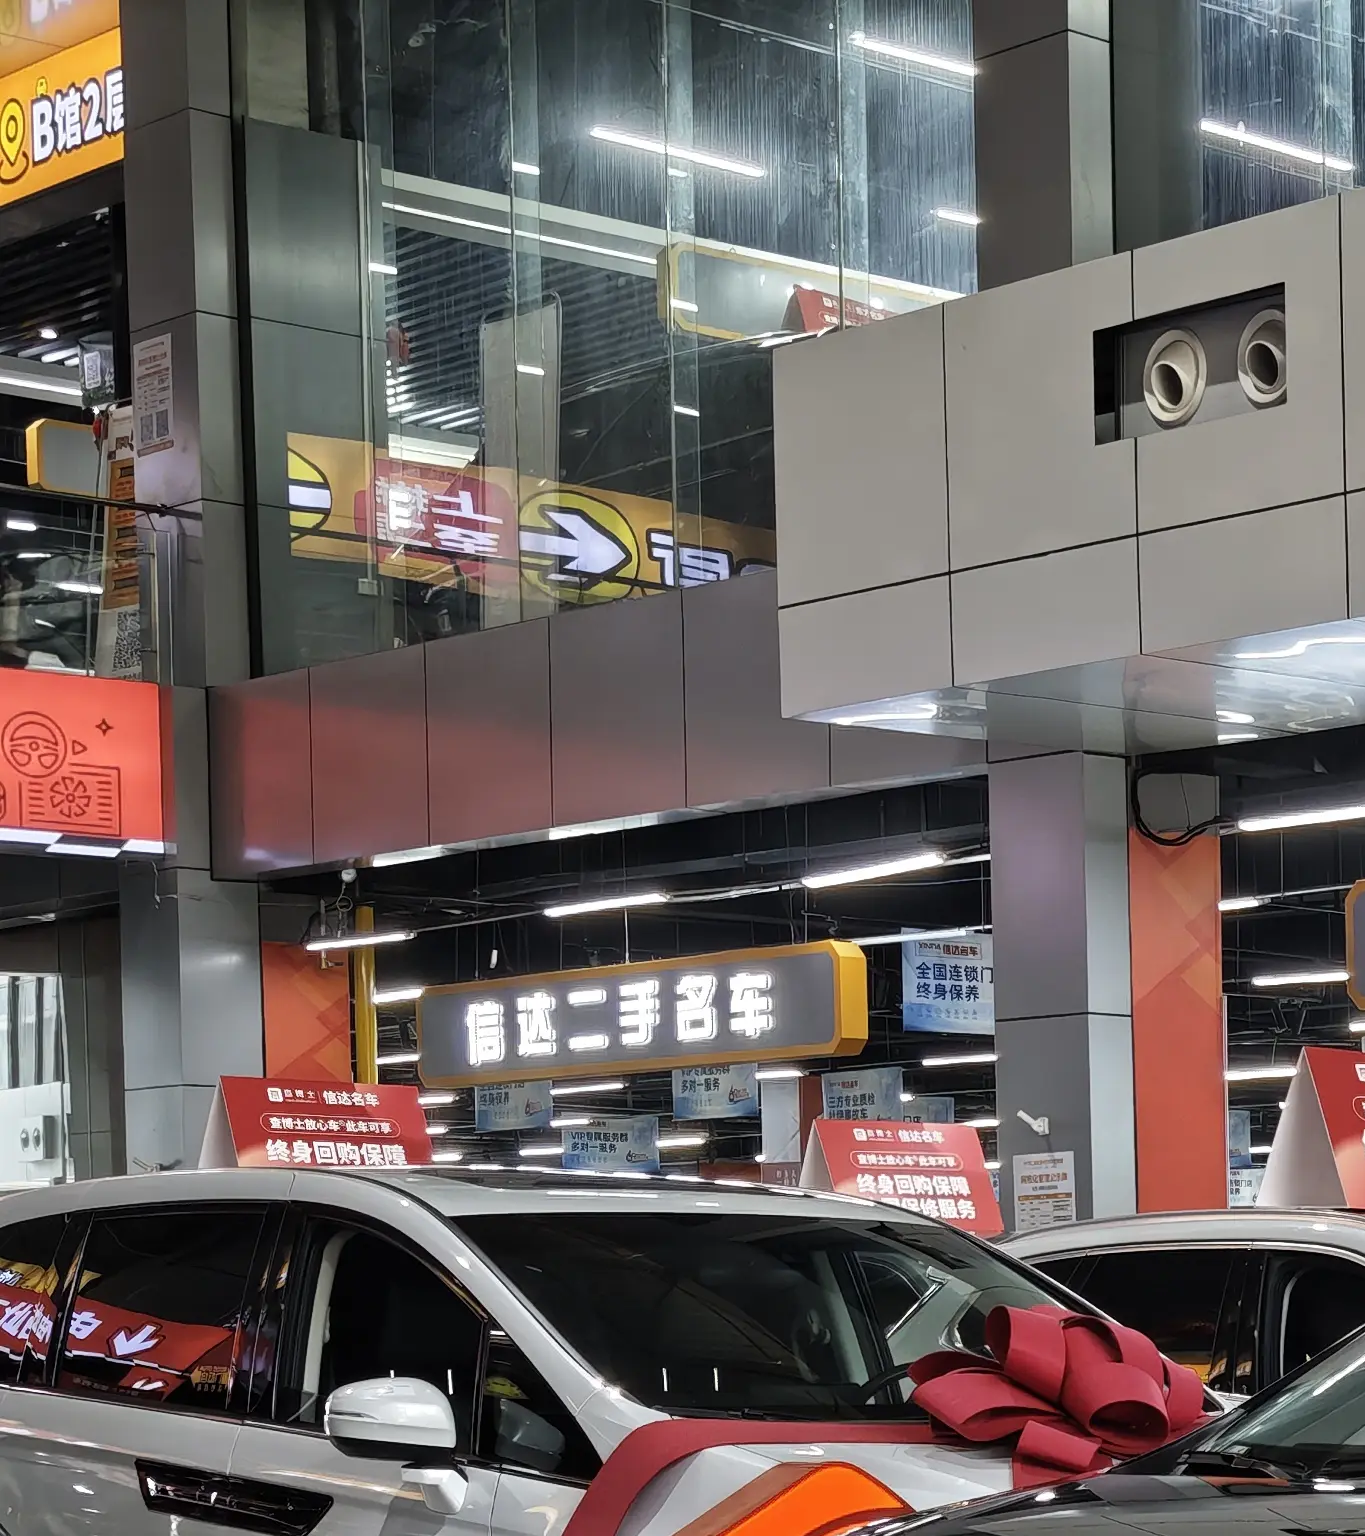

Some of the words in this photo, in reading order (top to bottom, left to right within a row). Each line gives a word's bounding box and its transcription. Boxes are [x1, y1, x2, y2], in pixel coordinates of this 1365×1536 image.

[32, 68, 124, 163] B馆2层
[915, 961, 994, 984] 全国连锁门
[916, 981, 980, 1002] 终身保养
[465, 971, 776, 1067] 信达二手名车
[323, 1090, 381, 1107] 信达名车
[266, 1138, 408, 1167] 终身回购保障
[855, 1173, 971, 1196] 终身回购保障
[860, 1195, 977, 1220] 保修服务
